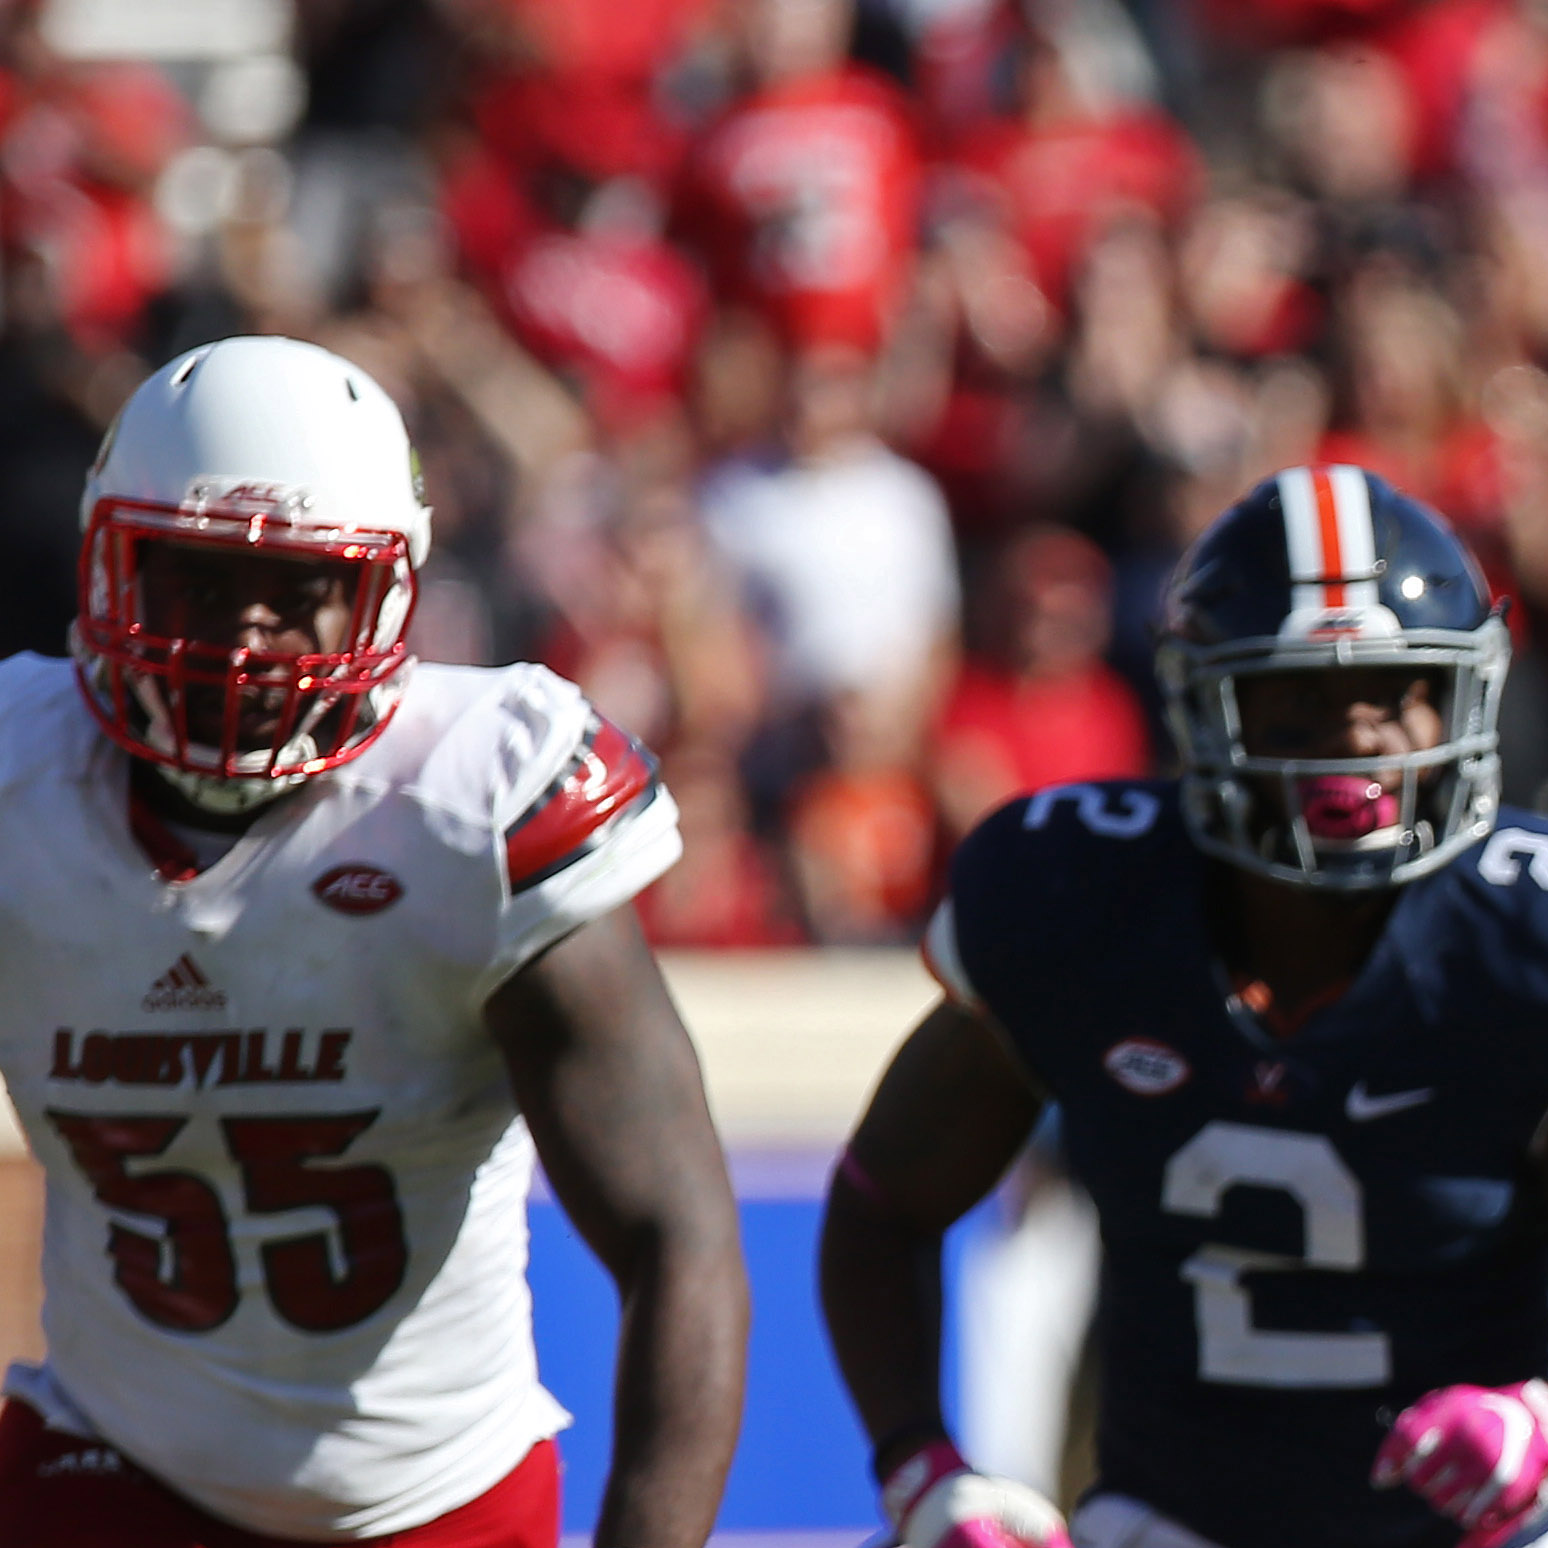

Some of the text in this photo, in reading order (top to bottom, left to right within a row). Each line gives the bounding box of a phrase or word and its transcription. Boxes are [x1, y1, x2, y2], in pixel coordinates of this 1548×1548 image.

[50, 1027, 352, 1089] LOUISVILLE
[43, 1105, 410, 1337] 55
[1159, 1117, 1394, 1392] 2
